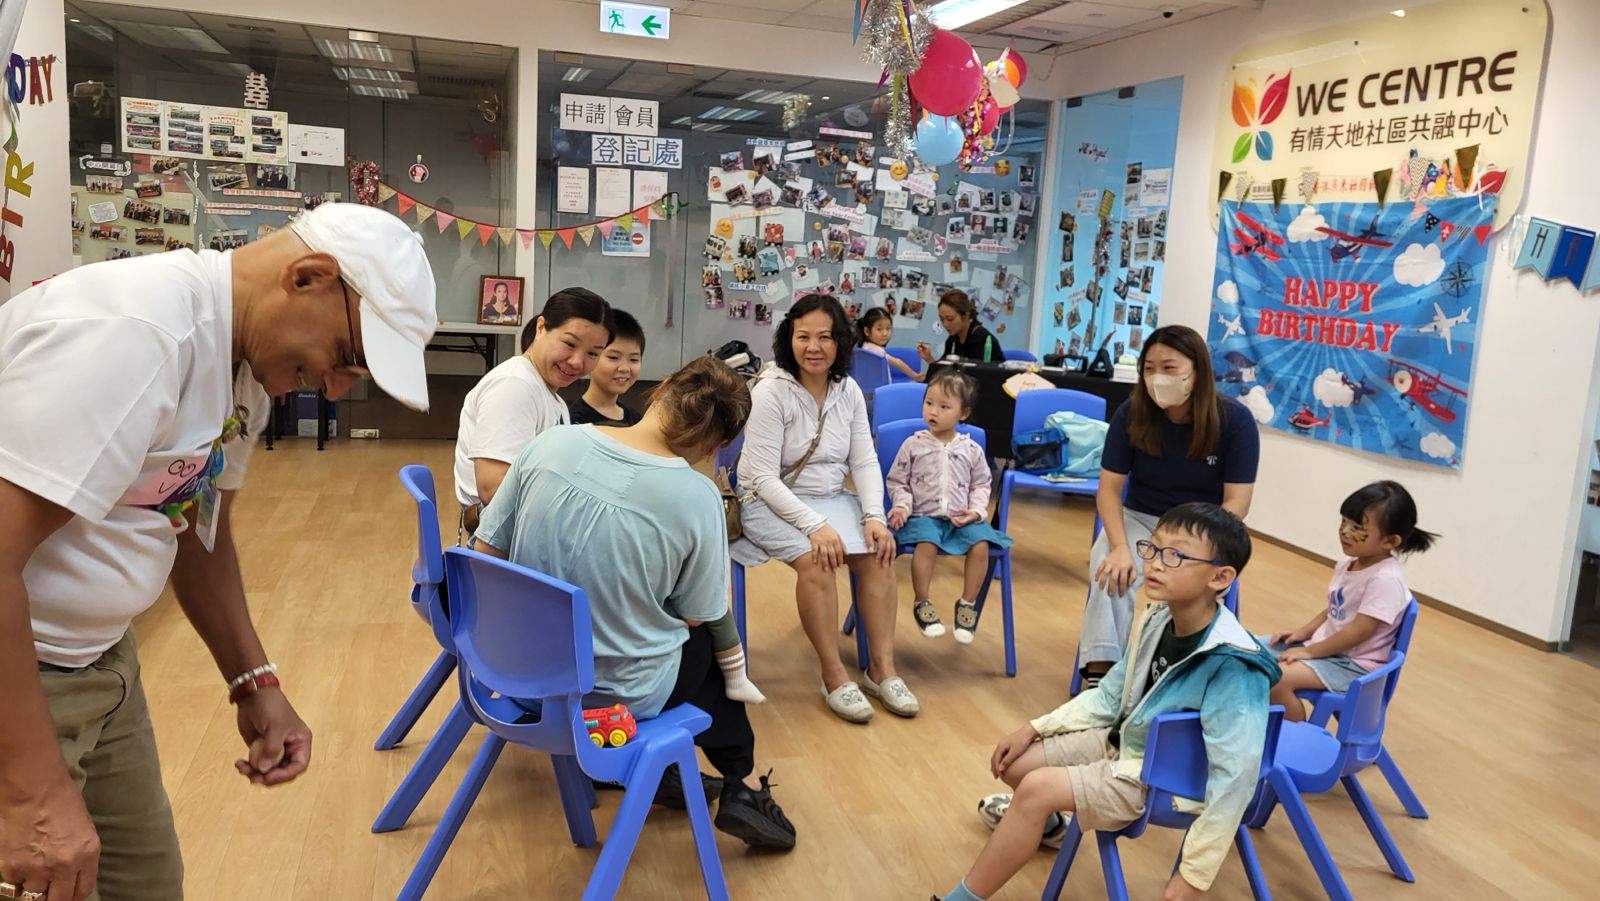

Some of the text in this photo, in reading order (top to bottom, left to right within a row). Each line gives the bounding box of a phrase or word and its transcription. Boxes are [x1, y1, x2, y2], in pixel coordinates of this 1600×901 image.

[1296, 50, 1518, 118] WE CENTRE
[565, 100, 655, 129] 申請會員
[1289, 105, 1509, 153] 有情天地社區共融中心
[593, 137, 680, 166] 登記處
[1283, 276, 1381, 314] HAPPY
[1256, 308, 1401, 354] BIRTHDAY
